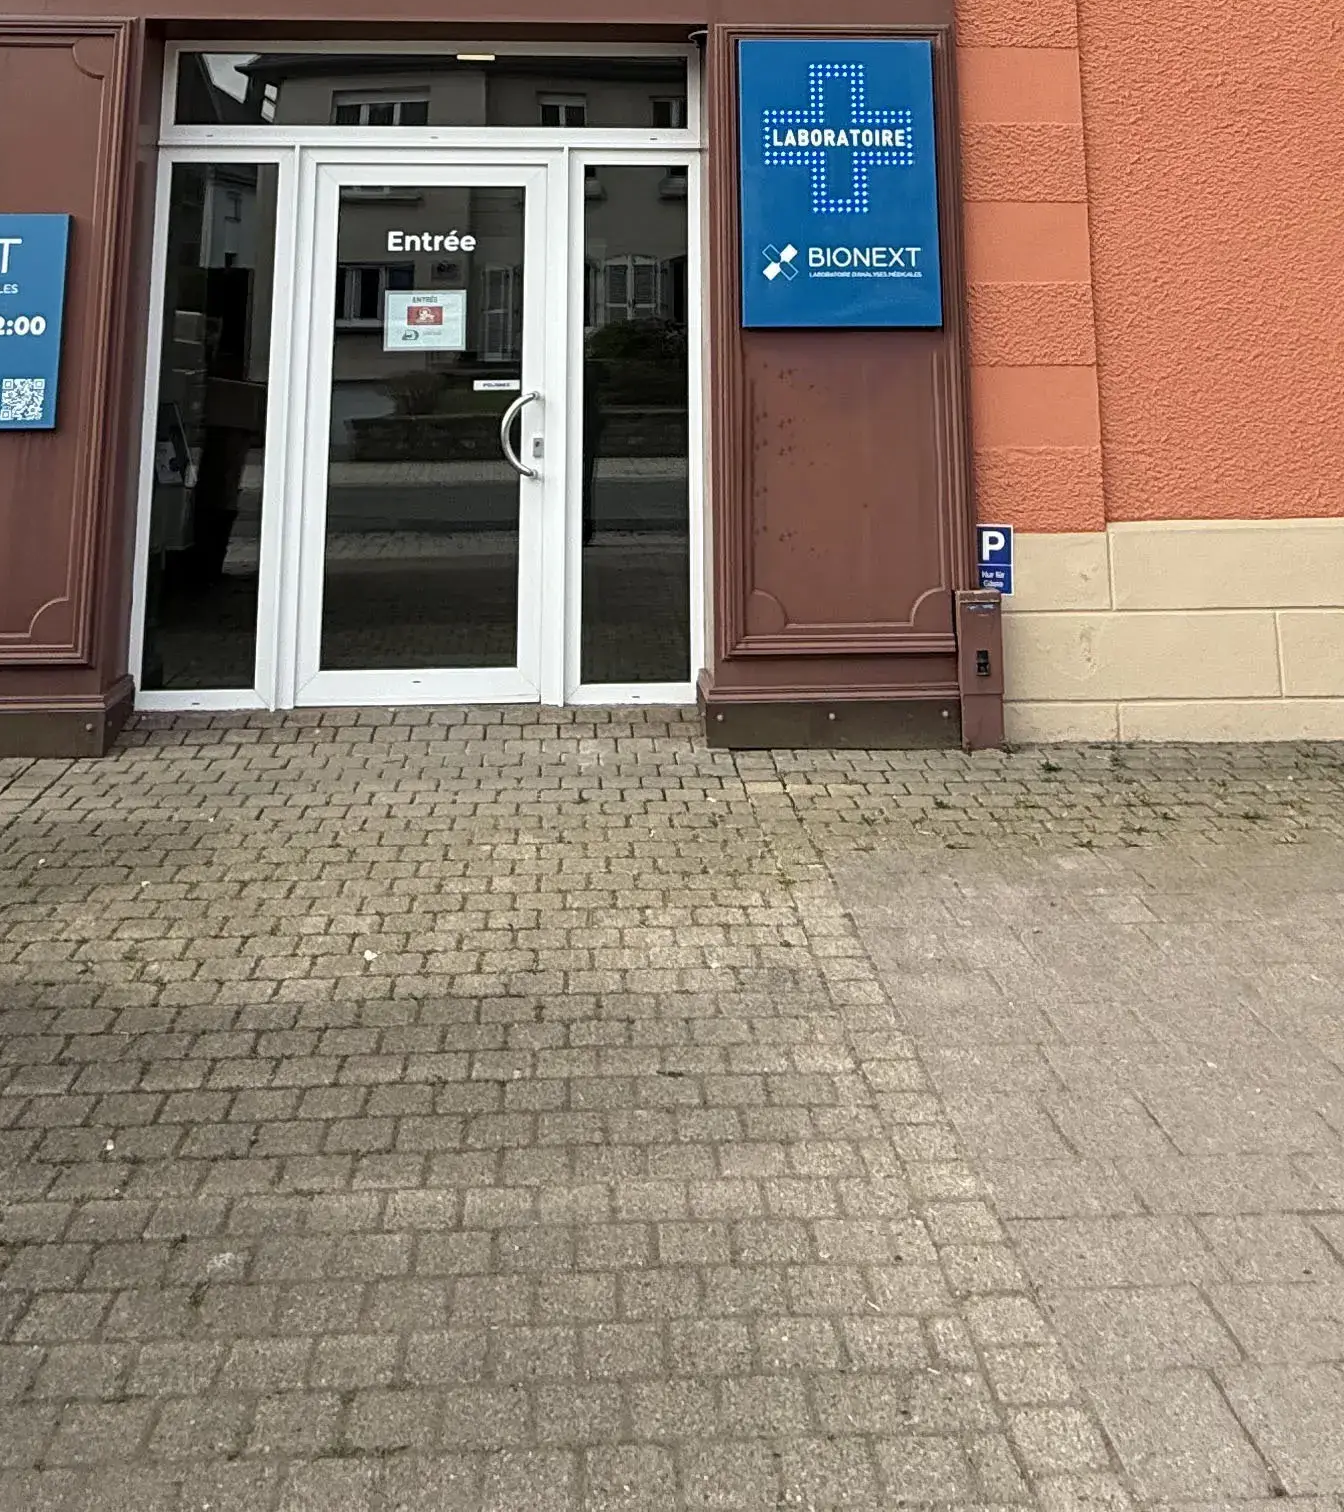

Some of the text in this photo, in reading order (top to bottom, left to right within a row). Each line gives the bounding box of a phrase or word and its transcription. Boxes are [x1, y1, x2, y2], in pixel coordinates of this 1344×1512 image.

[772, 128, 906, 147] LABORATOIRE
[387, 230, 477, 252] Entrée
[808, 246, 923, 268] BIONEXT
[982, 531, 1006, 561] P
